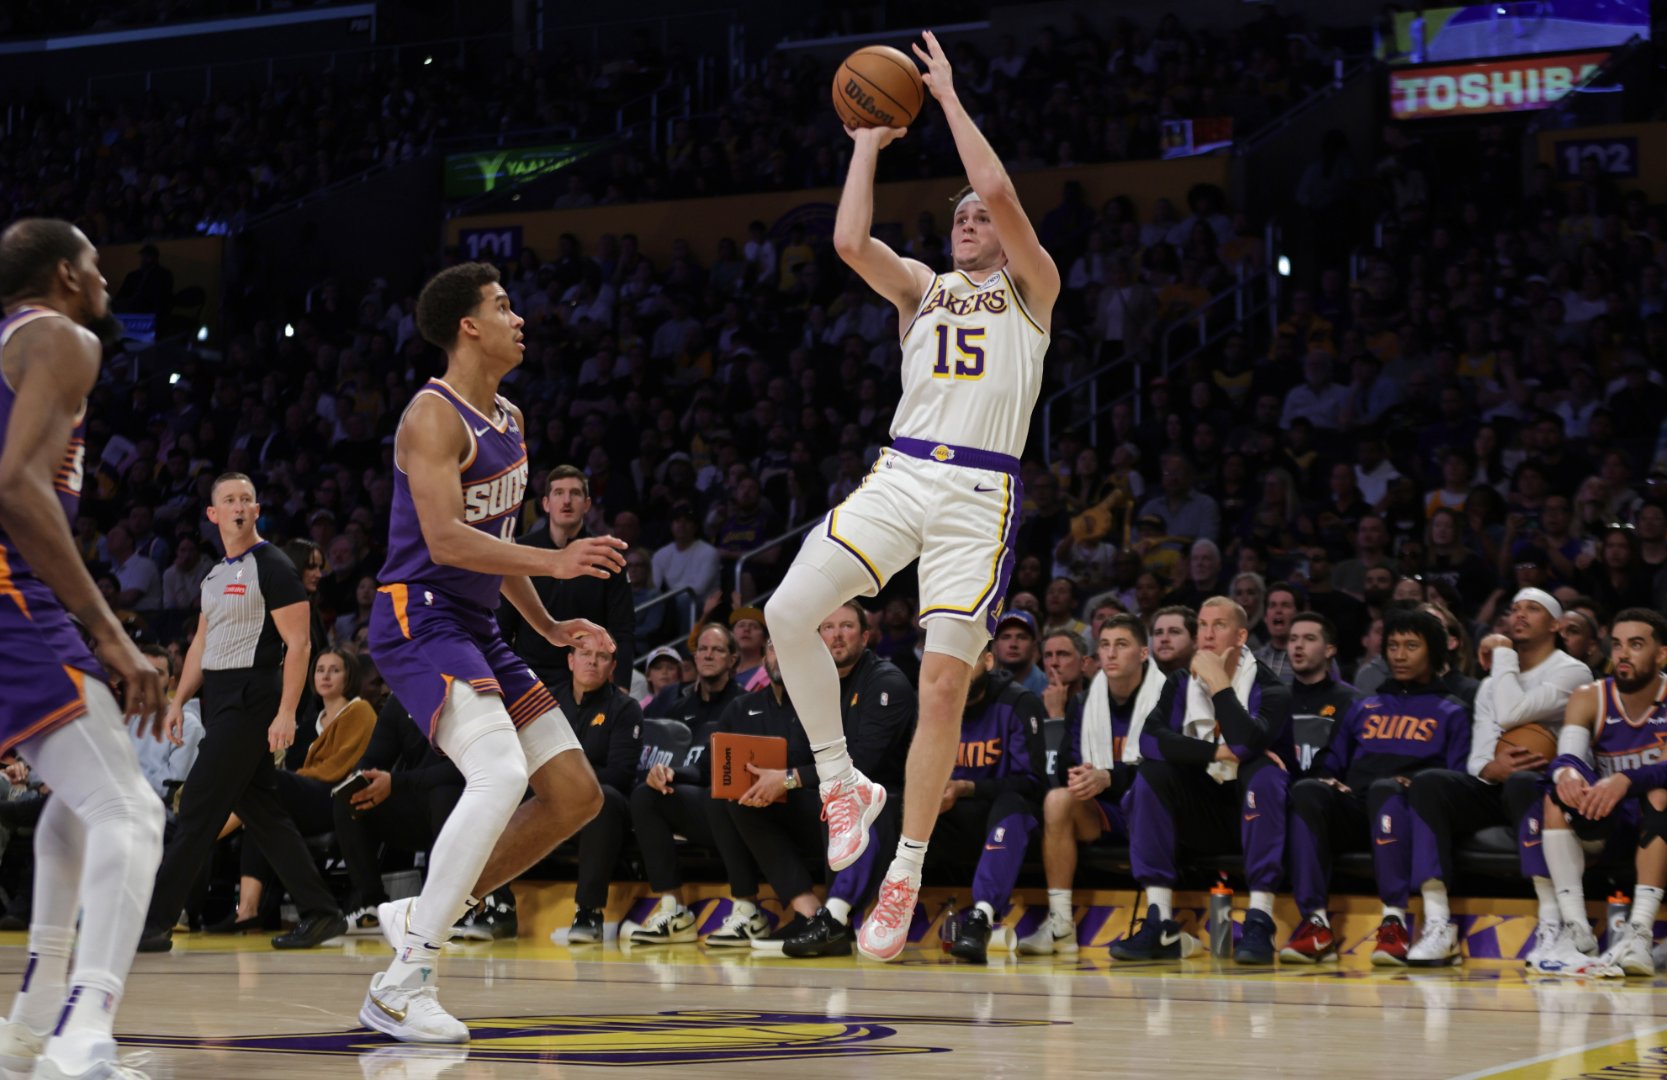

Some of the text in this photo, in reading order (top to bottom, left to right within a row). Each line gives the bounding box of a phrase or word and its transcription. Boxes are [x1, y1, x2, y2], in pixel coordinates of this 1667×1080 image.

[844, 78, 895, 124] Wilson
[1563, 143, 1633, 176] 102
[466, 231, 513, 260] 101
[932, 323, 988, 381] 15
[1362, 714, 1438, 742] SUNS
[722, 746, 732, 787] Wilson
